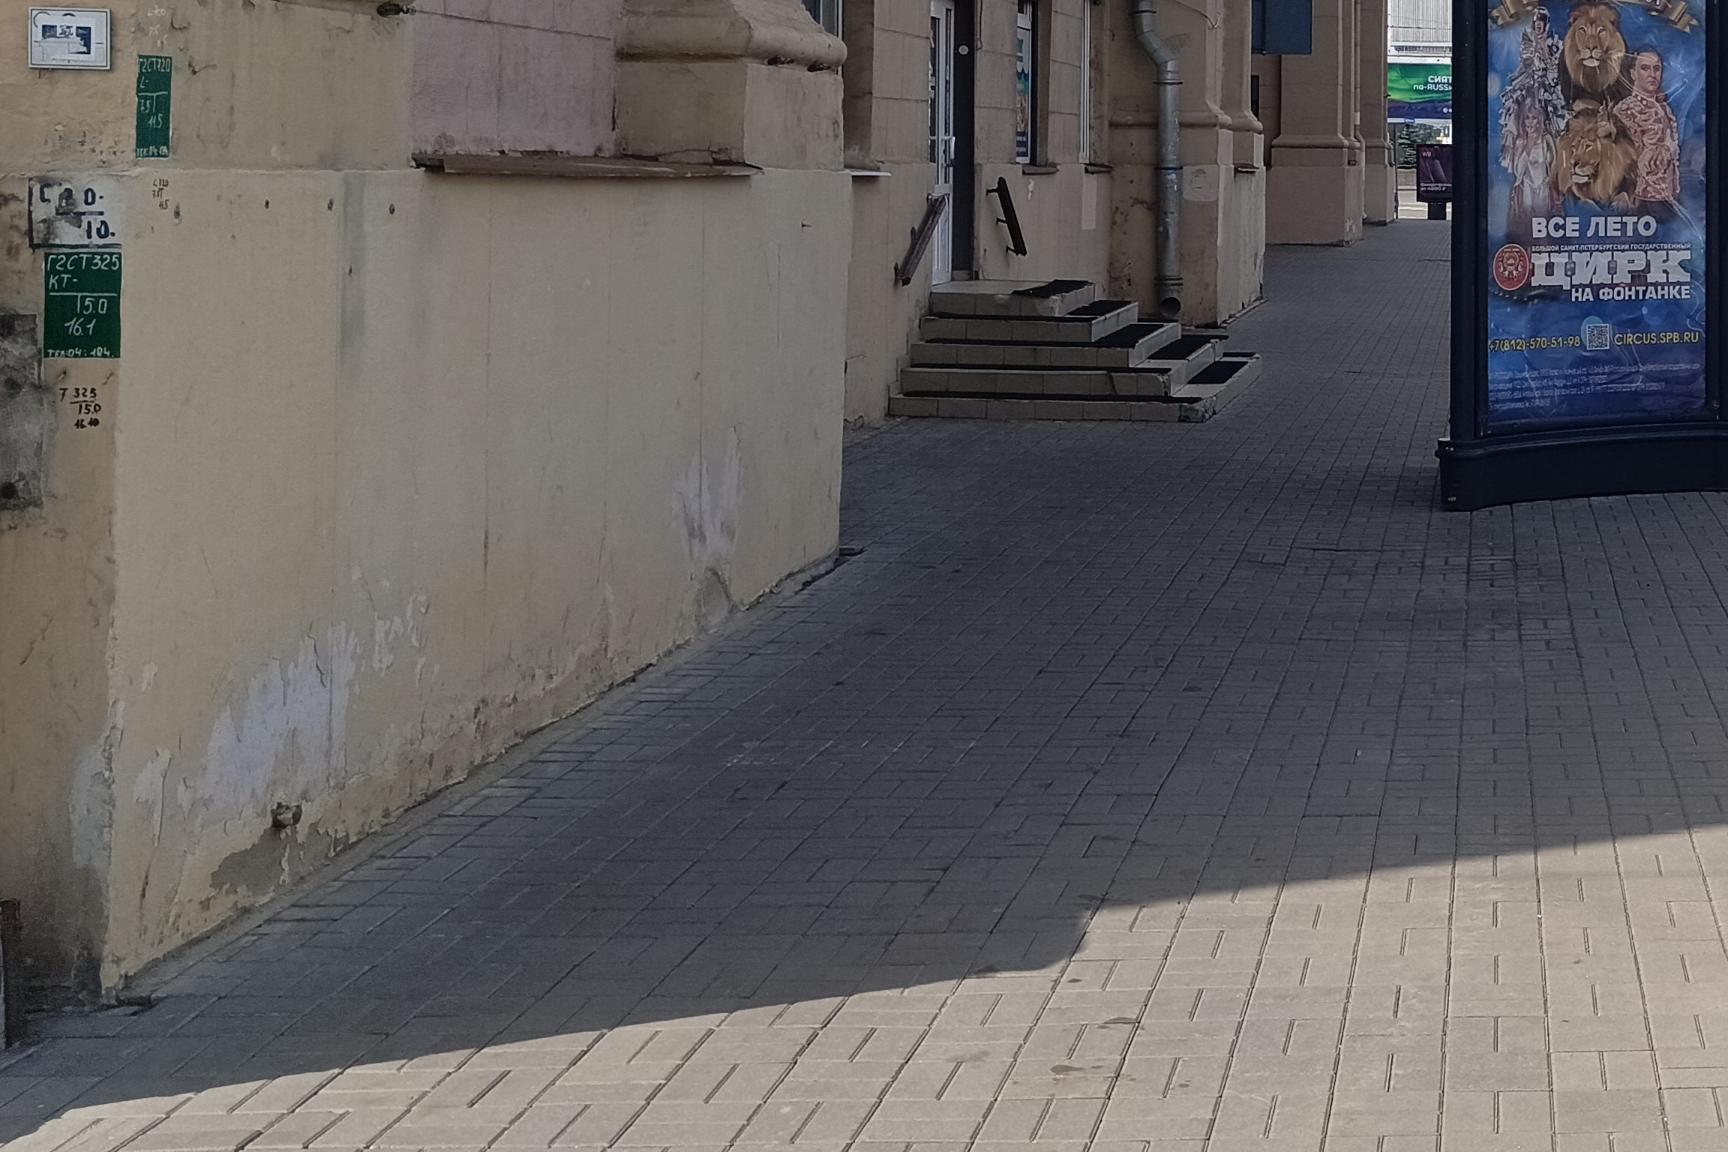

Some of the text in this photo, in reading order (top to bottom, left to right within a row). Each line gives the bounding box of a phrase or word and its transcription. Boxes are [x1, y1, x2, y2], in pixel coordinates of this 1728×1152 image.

[1532, 215, 1657, 238] ВСЕ ЛЕТО
[1531, 250, 1692, 290] ЦИРК
[1571, 285, 1691, 302] НА ФОНТАНКЕ
[1488, 331, 1699, 352] +7(812)-570-51-98 CIRCUS.SPB.RU
